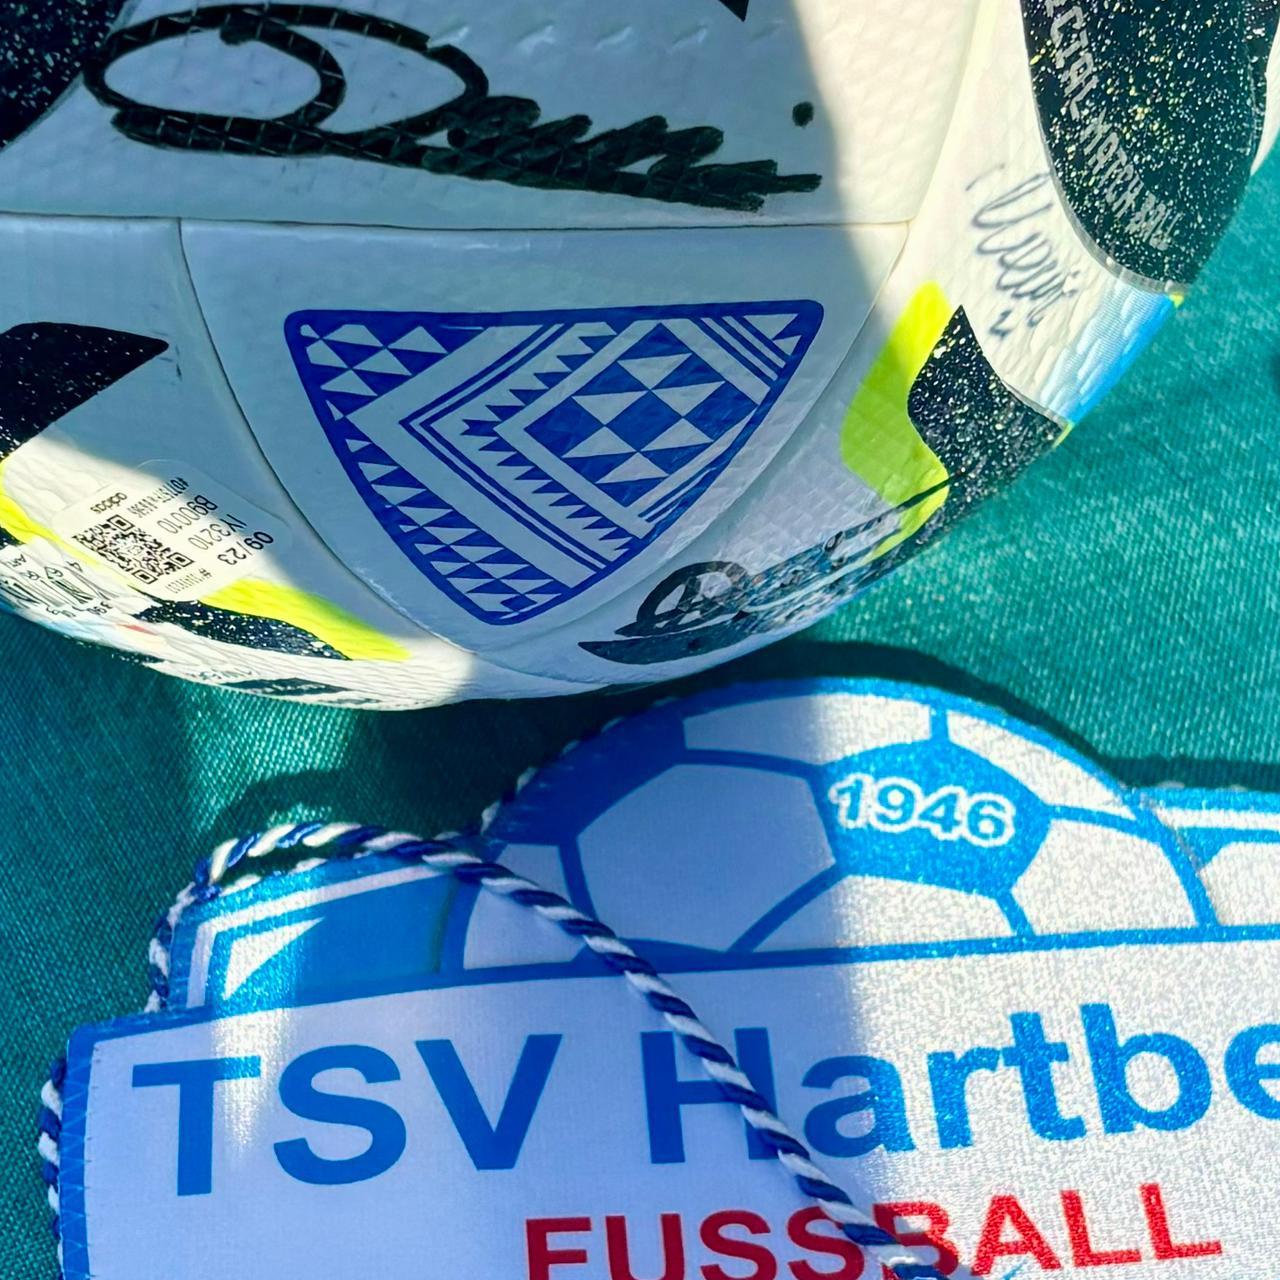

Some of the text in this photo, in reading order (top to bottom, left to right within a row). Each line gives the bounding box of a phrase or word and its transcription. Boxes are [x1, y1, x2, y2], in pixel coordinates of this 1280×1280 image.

[1080, 107, 1145, 220] MATCH
[1124, 192, 1184, 251] BALL
[89, 491, 128, 514] adidas
[187, 513, 248, 551] IY3210
[217, 530, 275, 566] 09/23
[827, 772, 1017, 848] 1946
[131, 1033, 563, 1196] TSV
